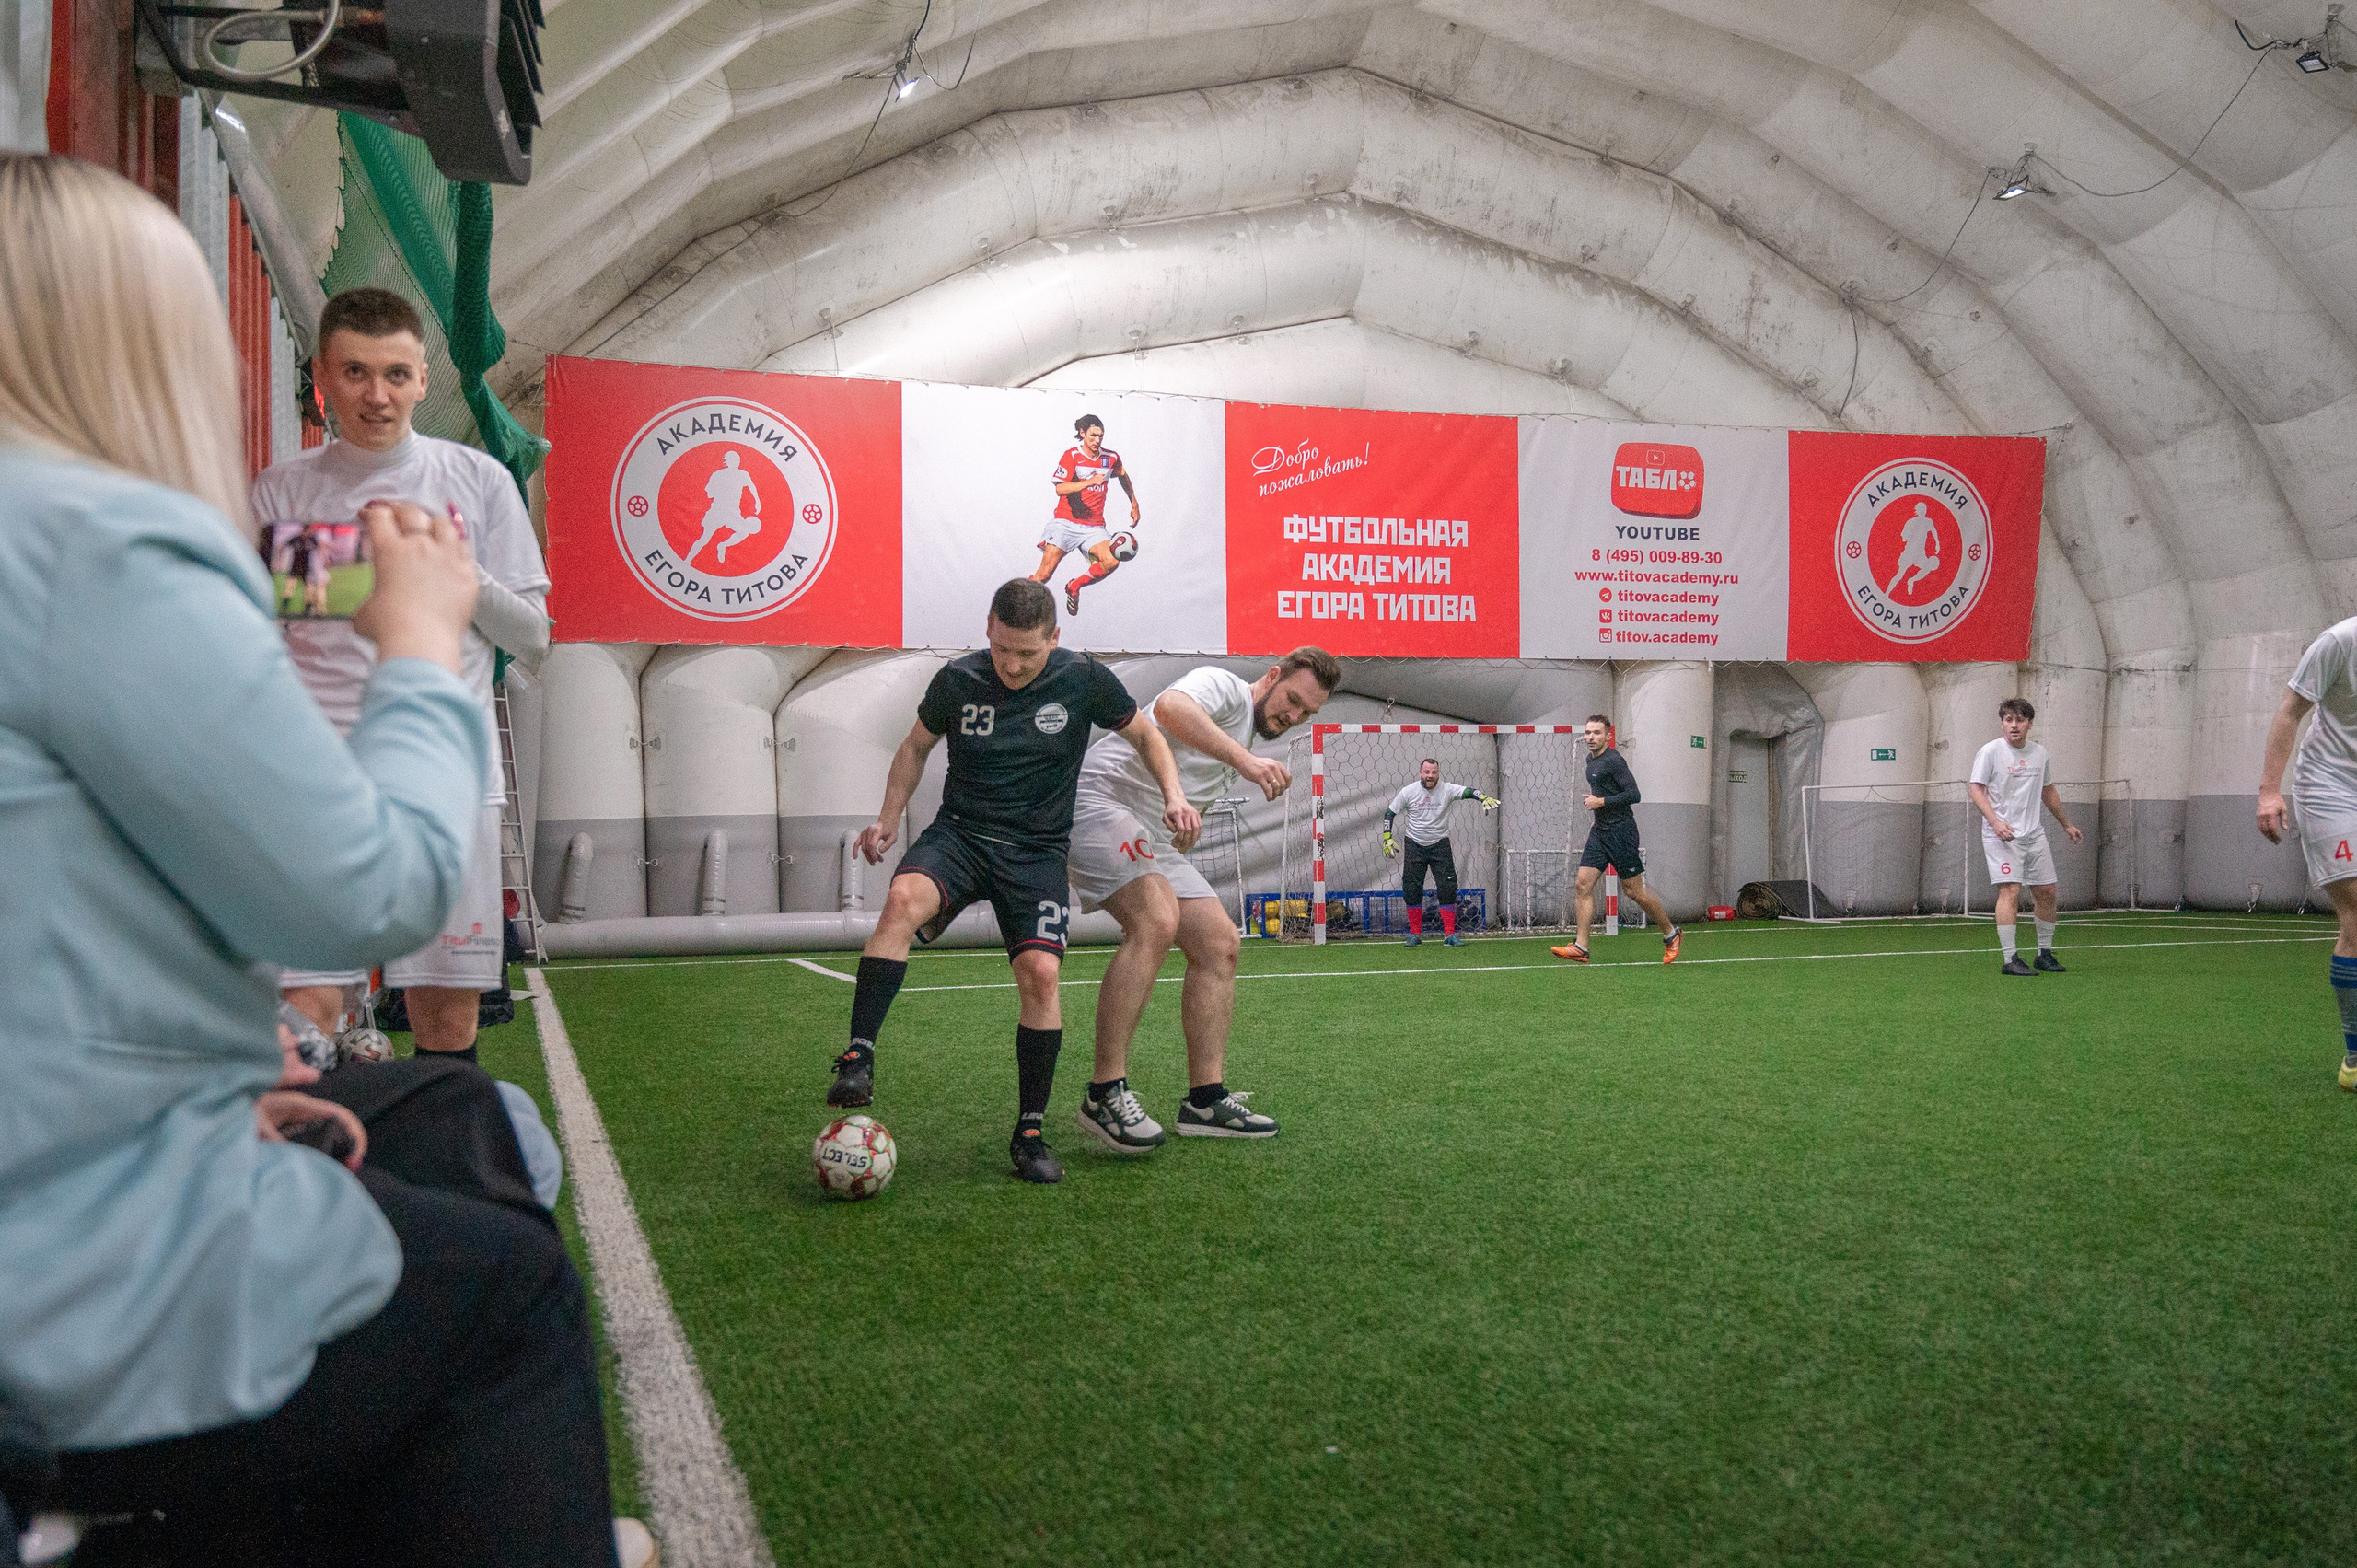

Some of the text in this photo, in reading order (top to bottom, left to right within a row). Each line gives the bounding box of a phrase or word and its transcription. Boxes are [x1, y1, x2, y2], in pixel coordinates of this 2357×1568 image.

[656, 413, 798, 462] АКАДЕМИЯ
[1251, 438, 1319, 477] Добро
[1259, 442, 1369, 497] пожаловать!
[1867, 471, 1968, 510] АКАДЕМИЯ
[1283, 514, 1469, 547] ФУТБОЛЬНАЯ
[1616, 526, 1700, 540] YOUTUBE
[1302, 552, 1451, 586] АКАДЕМИЯ
[1592, 549, 1723, 564] 8 (495) 009-89-30
[645, 550, 808, 605] ЕГОРА ТИТОВА
[1575, 570, 1738, 587] www.titovacademy.ru
[1277, 590, 1477, 621] ЕГОРА ТИТОВА
[1618, 590, 1719, 606] titovacademy
[1858, 585, 1969, 630] ЕГОРА ТИТОВА
[1618, 610, 1719, 626] titovacademy
[1616, 630, 1719, 646] titov.academy
[961, 704, 995, 736] 23
[2334, 840, 2353, 862] 4
[2001, 862, 2011, 875] 6
[822, 1148, 867, 1168] SELECT
